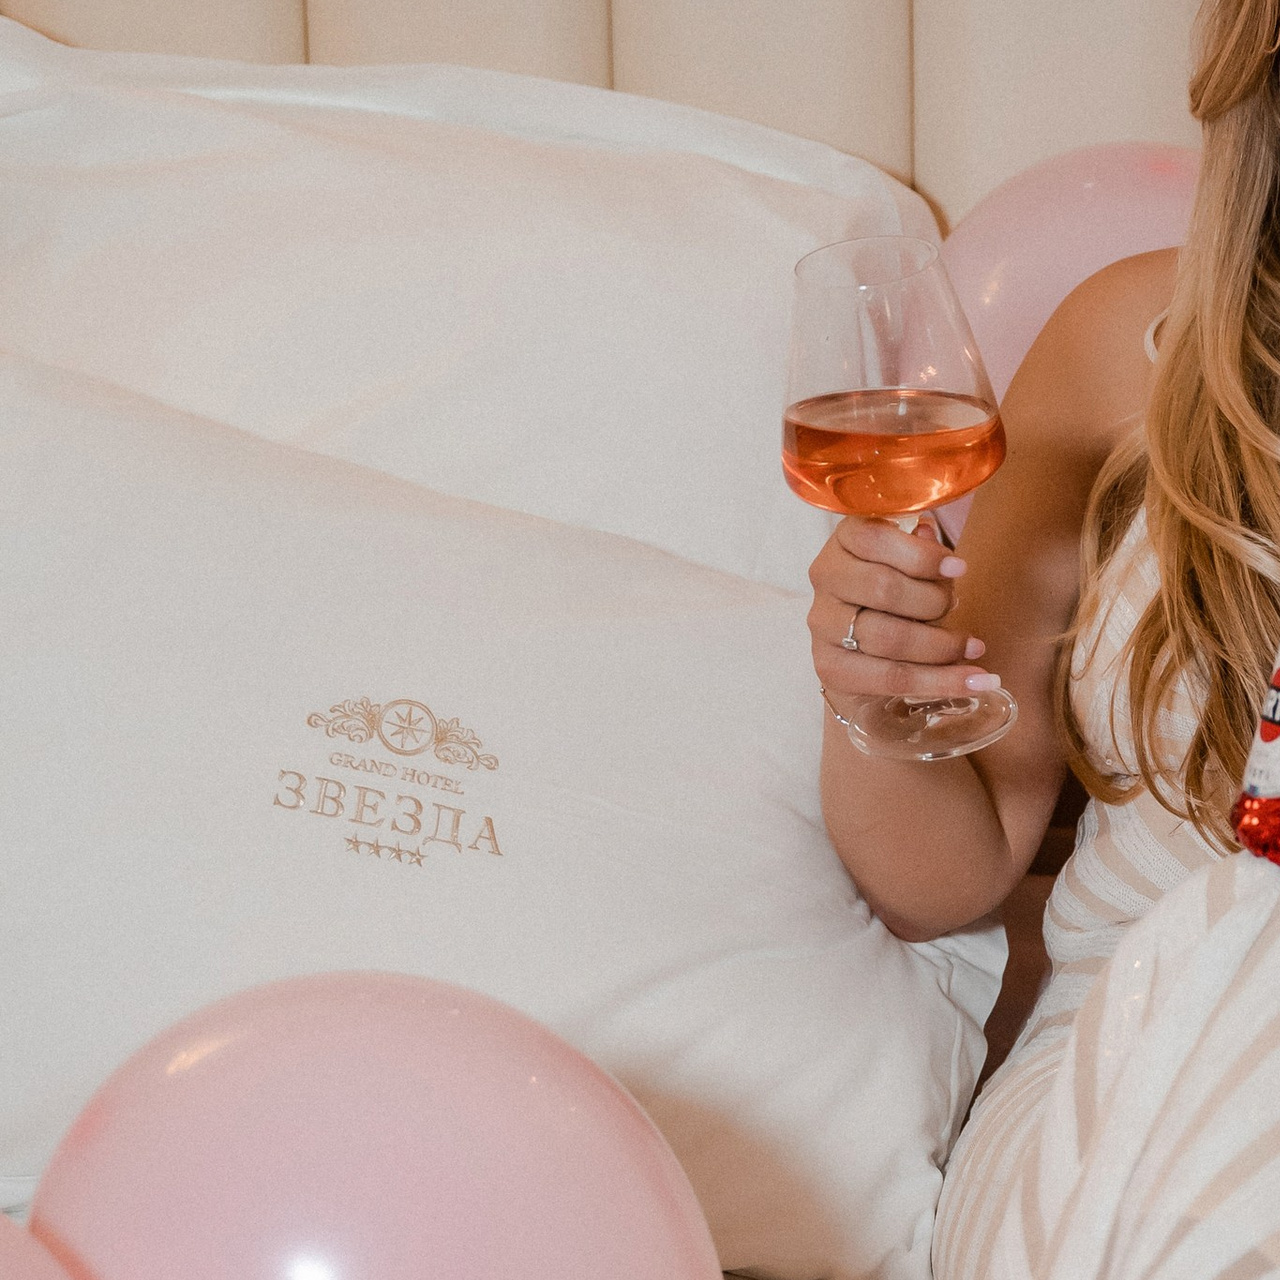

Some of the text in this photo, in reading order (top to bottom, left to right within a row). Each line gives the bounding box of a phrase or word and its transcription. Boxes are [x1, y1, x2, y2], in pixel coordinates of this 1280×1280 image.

[329, 752, 465, 795] GRAND HOTEL
[272, 769, 503, 856] ЗВЕЗДА
